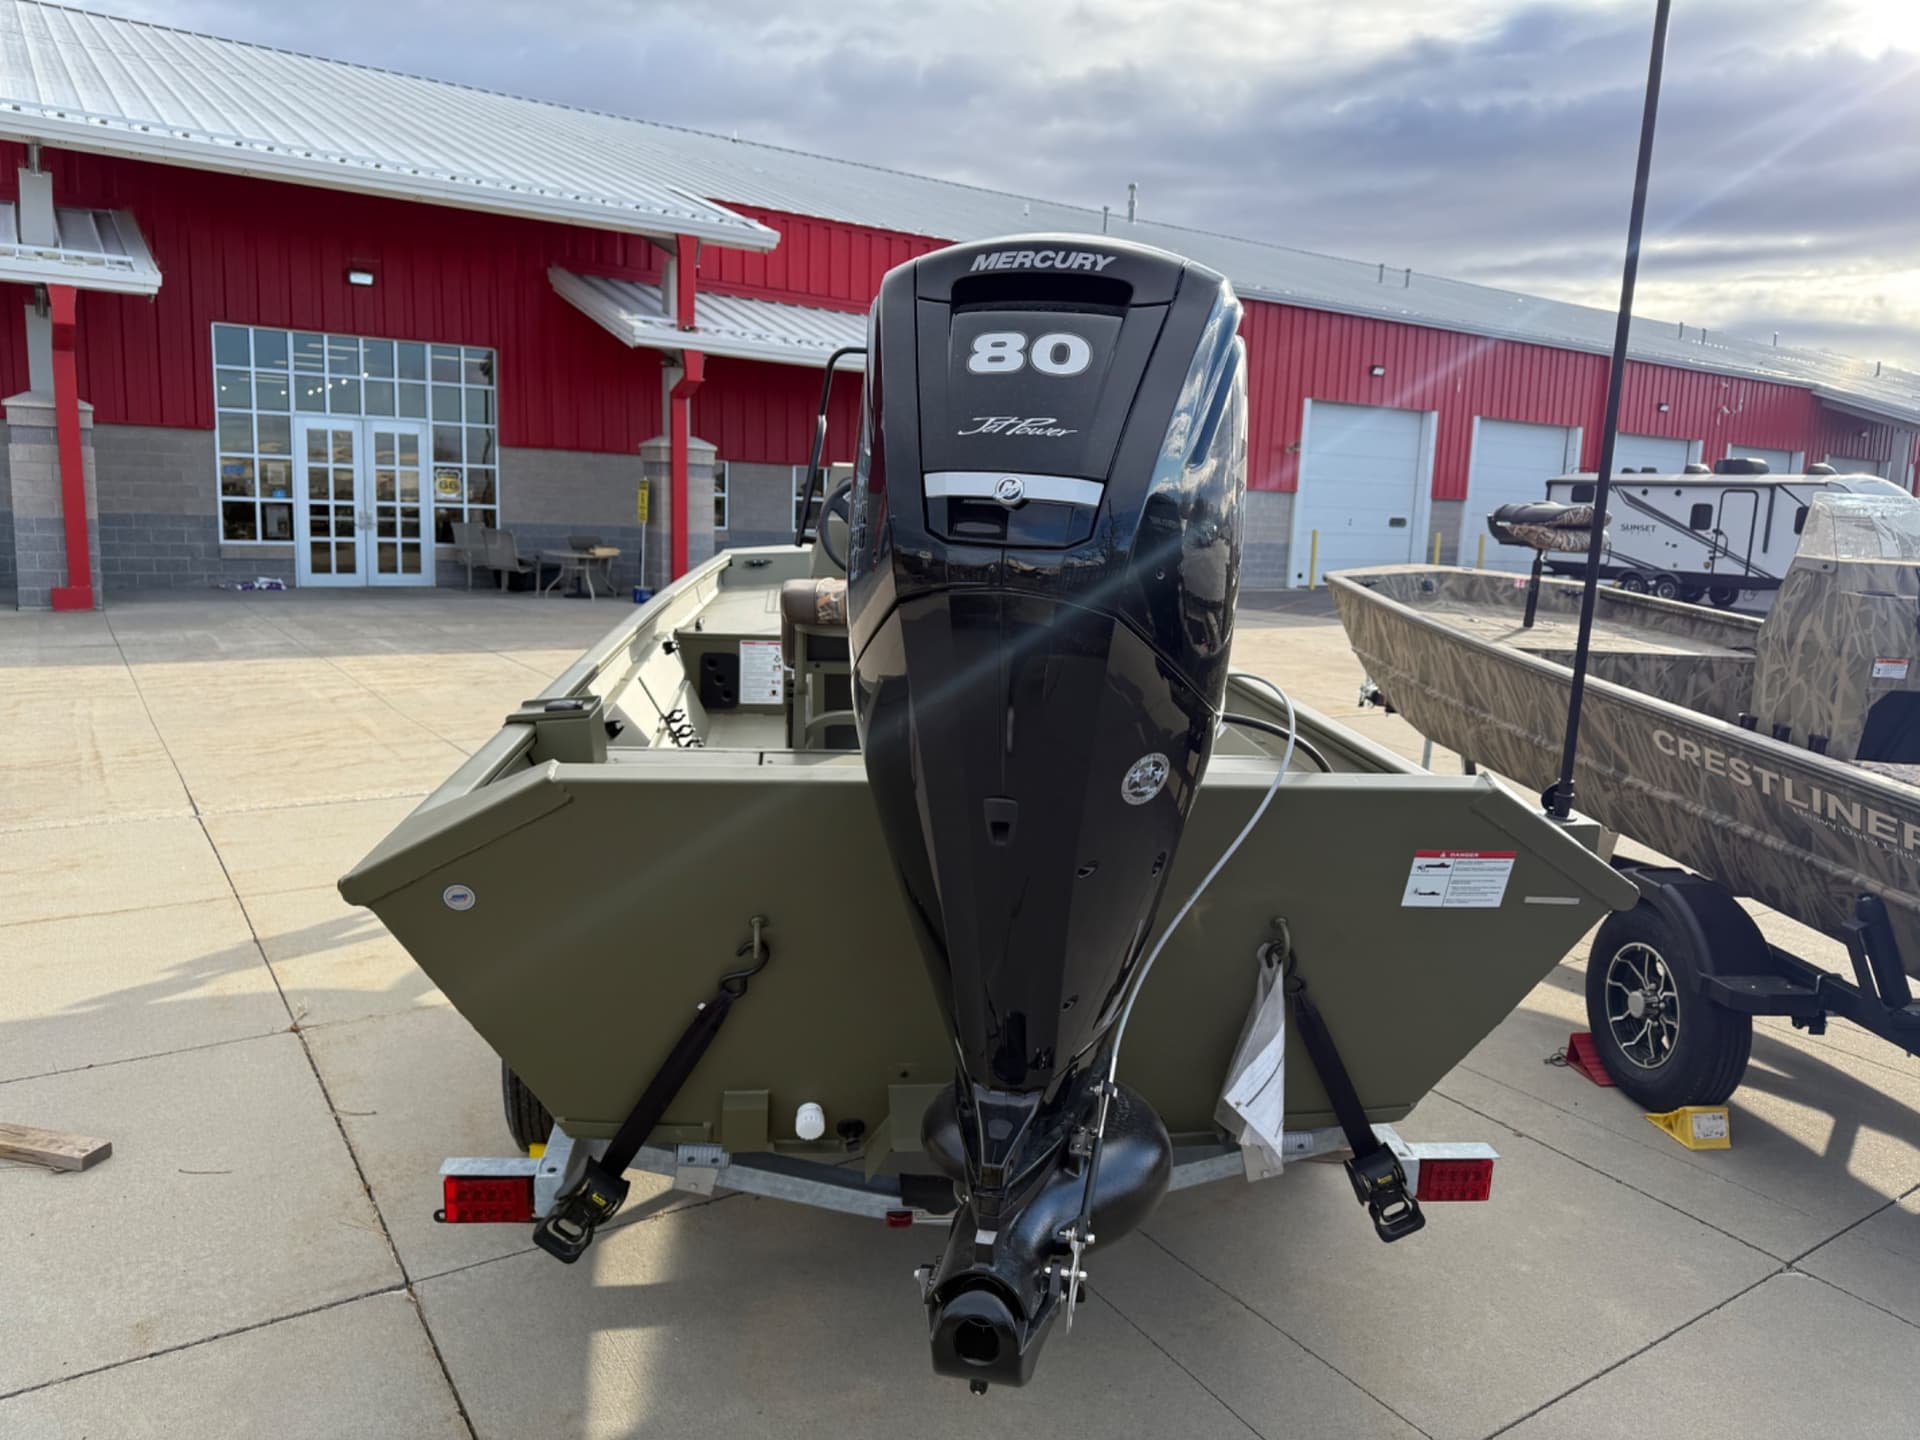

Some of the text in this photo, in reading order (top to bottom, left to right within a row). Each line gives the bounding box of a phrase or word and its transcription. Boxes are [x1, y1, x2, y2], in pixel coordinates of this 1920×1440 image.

[969, 249, 1117, 273] MERCURY
[967, 331, 1092, 376] 80
[957, 416, 1078, 437] Jet Power
[1621, 523, 1656, 533] SUNSET
